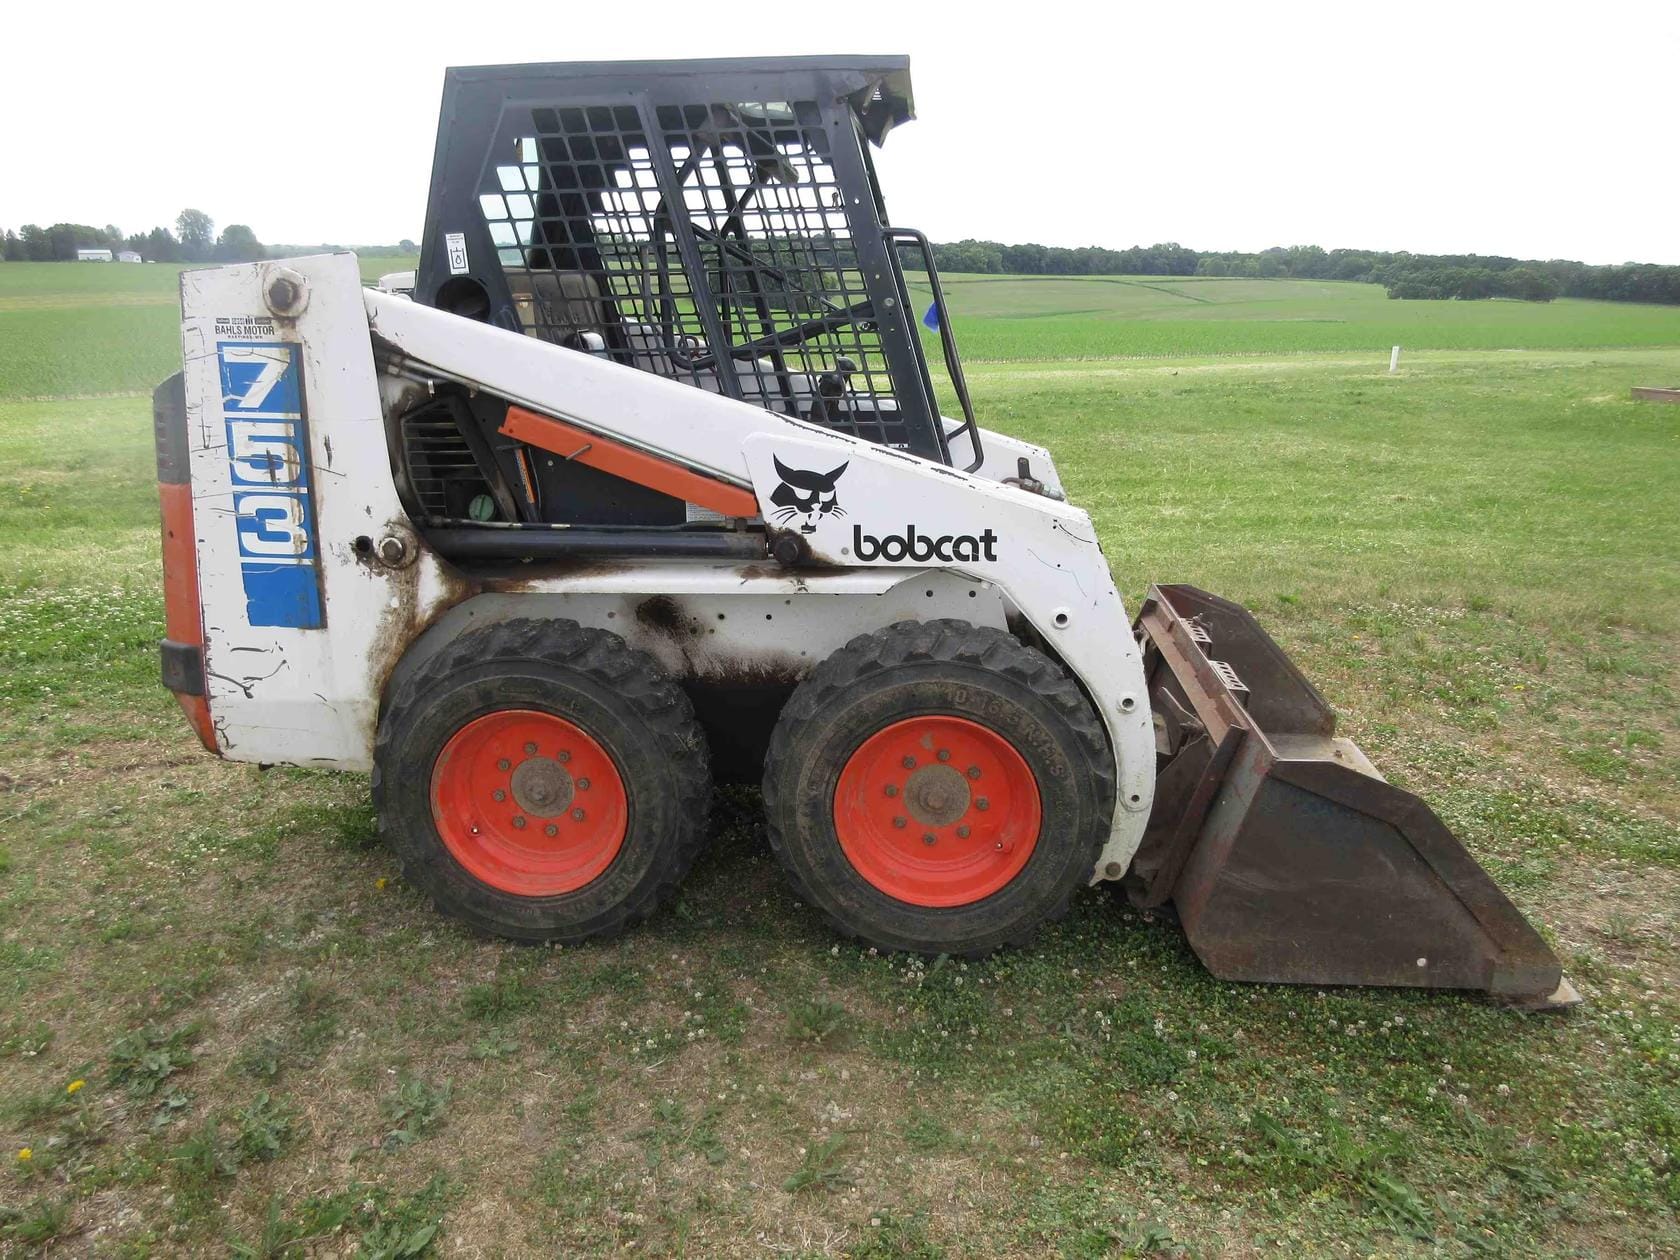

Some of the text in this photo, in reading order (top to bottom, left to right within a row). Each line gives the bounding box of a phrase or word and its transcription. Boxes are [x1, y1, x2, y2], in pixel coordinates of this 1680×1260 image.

[215, 325, 275, 336] BAHLS MOTOR
[222, 346, 308, 555] 753
[853, 524, 998, 562] bobcat
